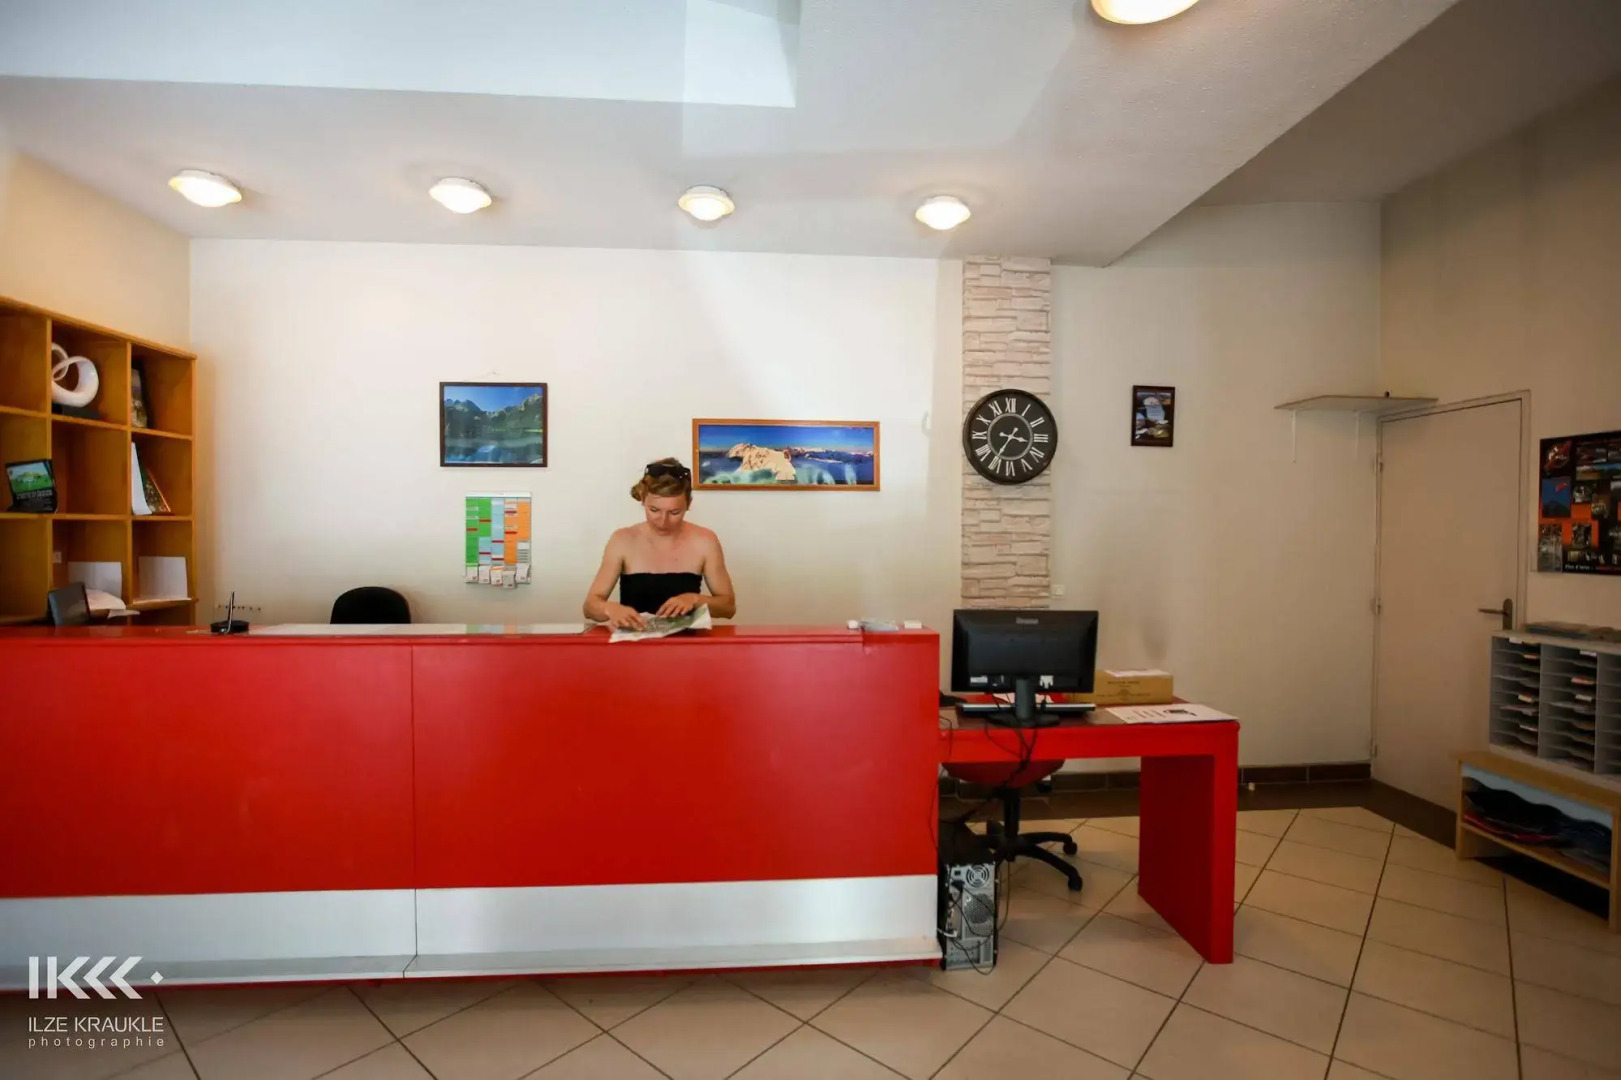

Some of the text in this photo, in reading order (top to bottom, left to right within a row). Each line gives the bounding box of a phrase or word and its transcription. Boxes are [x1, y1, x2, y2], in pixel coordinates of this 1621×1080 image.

[988, 400, 1003, 417] XI
[1005, 398, 1016, 413] XII
[1021, 404, 1031, 416] I
[976, 415, 992, 425] X
[1030, 417, 1045, 427] II
[972, 430, 987, 439] IX
[1033, 433, 1048, 443] III
[975, 444, 991, 462] VIII
[1029, 447, 1045, 463] IV
[988, 456, 1002, 474] VII
[1005, 461, 1015, 476] VI
[1021, 458, 1033, 473] V
